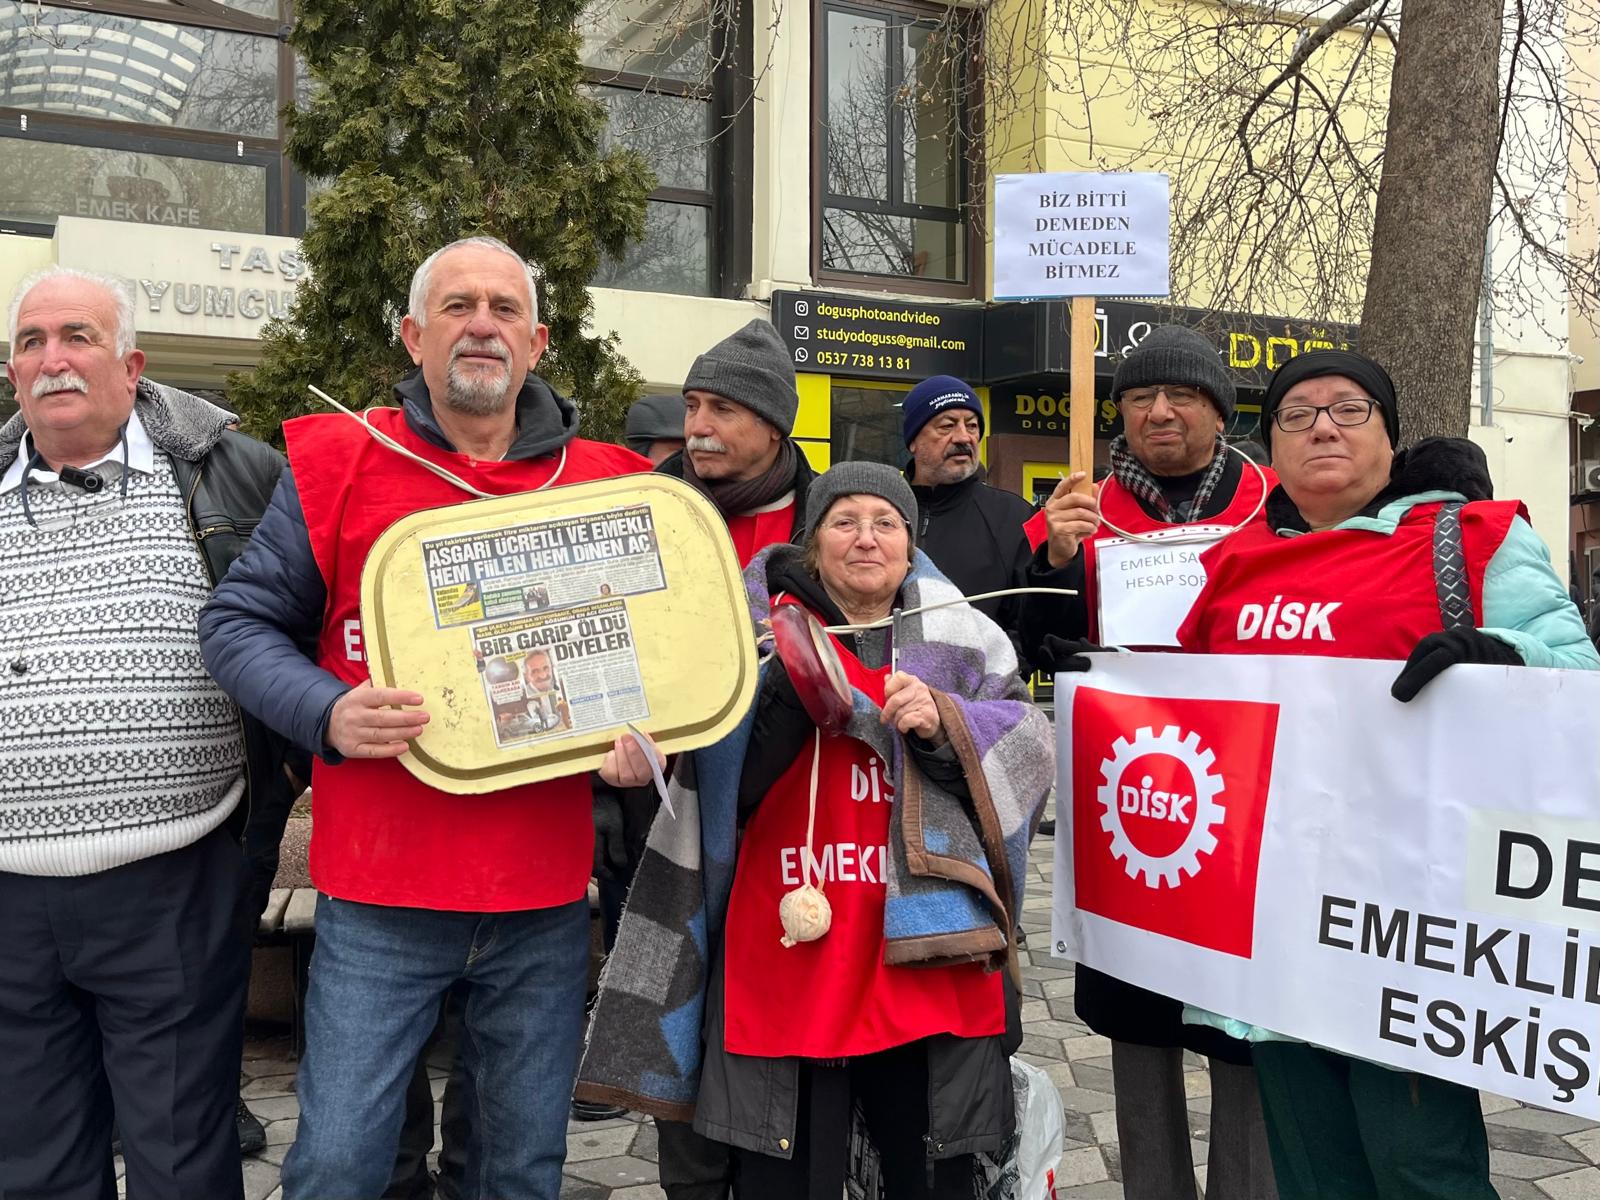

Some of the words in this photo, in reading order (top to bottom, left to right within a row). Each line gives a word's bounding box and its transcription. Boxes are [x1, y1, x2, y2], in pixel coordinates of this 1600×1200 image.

[75, 197, 139, 221] EMEK
[146, 203, 200, 225] KAFE
[1039, 191, 1071, 208] BİZ
[1076, 190, 1127, 207] BİTTİ
[1036, 217, 1130, 232] DEMEDEN
[1028, 239, 1137, 256] MÜCADELE
[1046, 262, 1120, 279] BİTMEZ
[127, 278, 297, 320] YUMCU
[817, 303, 940, 325] dogusphotoandvideo
[817, 328, 966, 351] studyodoguss@gmail.com
[817, 352, 847, 366] 0537
[852, 354, 875, 367] 738
[878, 356, 893, 369] 13
[896, 357, 911, 370] 81
[1015, 391, 1118, 425] DOĞŞ
[1022, 420, 1108, 432] DIGIL
[430, 540, 491, 568] ASGARİ
[495, 528, 564, 556] ÜCRETLİ
[567, 524, 589, 544] VE
[591, 515, 652, 540] EMEKLİ
[430, 564, 471, 587] HEM
[473, 554, 527, 579] FİİLEN
[530, 546, 569, 570] HEM
[572, 538, 624, 563] DİNEN
[629, 534, 651, 554] AÇ
[1120, 551, 1174, 571] EMEKLİ
[1179, 551, 1199, 563] SA
[1126, 574, 1174, 589] HESAP
[1237, 595, 1343, 642] DİSK
[480, 635, 512, 657] BİR
[516, 624, 573, 650] GARİP
[578, 614, 627, 638] ÖLDÜ
[554, 631, 631, 662] DİYELER
[851, 757, 894, 803] DİS
[1121, 774, 1192, 825] DİSK
[780, 843, 888, 886] EMEKL
[1495, 830, 1600, 912] DE
[1379, 986, 1600, 1103] ESKİŞ
